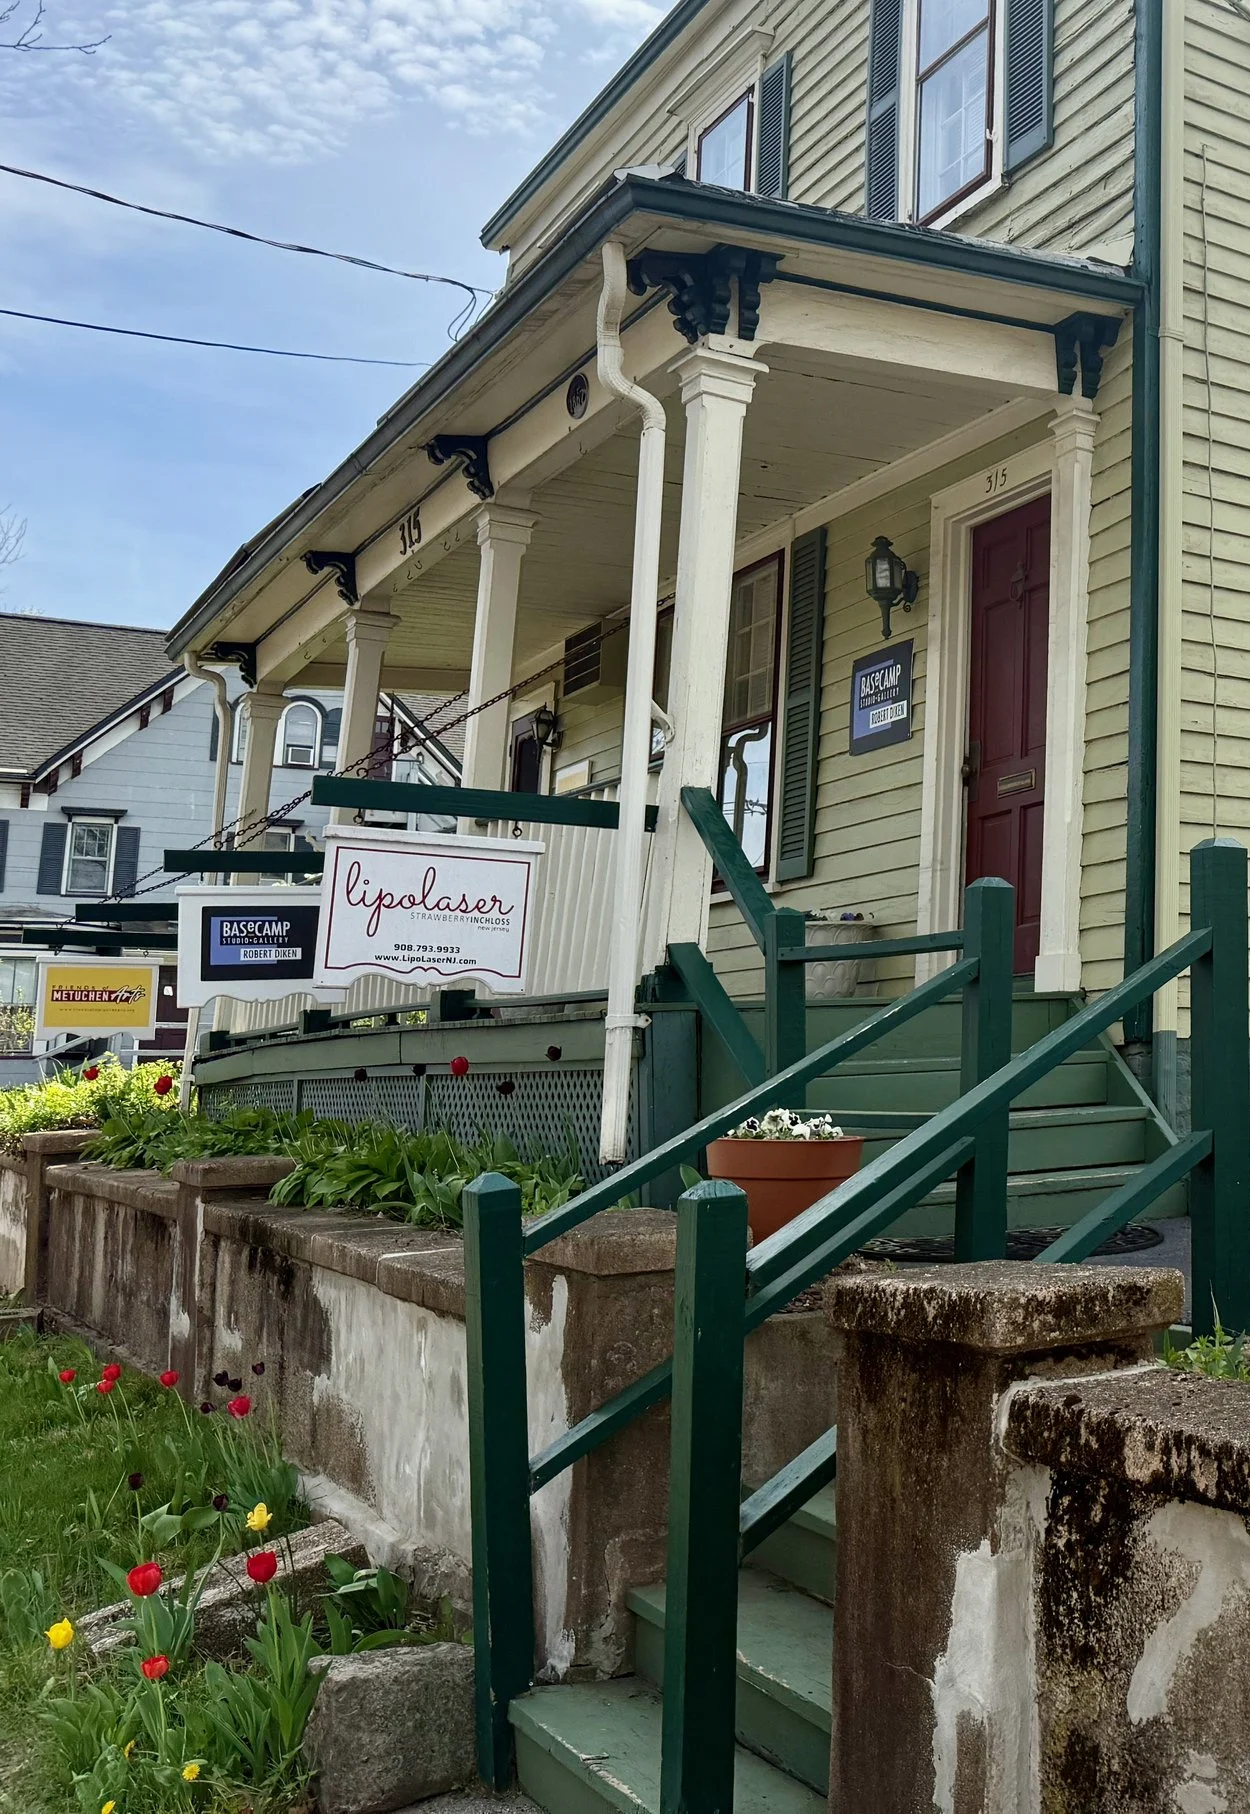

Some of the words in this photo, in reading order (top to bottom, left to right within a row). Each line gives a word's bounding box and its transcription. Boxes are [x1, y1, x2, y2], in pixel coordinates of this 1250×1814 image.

[986, 467, 1007, 493] 315
[399, 506, 422, 556] 315
[871, 707, 889, 725] ROBERT
[889, 702, 905, 719] DIKEN
[346, 860, 515, 938] lipolaser
[491, 925, 510, 933] jersey
[243, 949, 273, 959] ROBERT
[274, 948, 298, 958] DIKEN
[393, 943, 461, 954] 908.793.9933
[374, 953, 477, 965] www.LipoLaserNJ.com
[53, 990, 109, 1001] METUCHEN
[110, 984, 146, 1004] Arts
